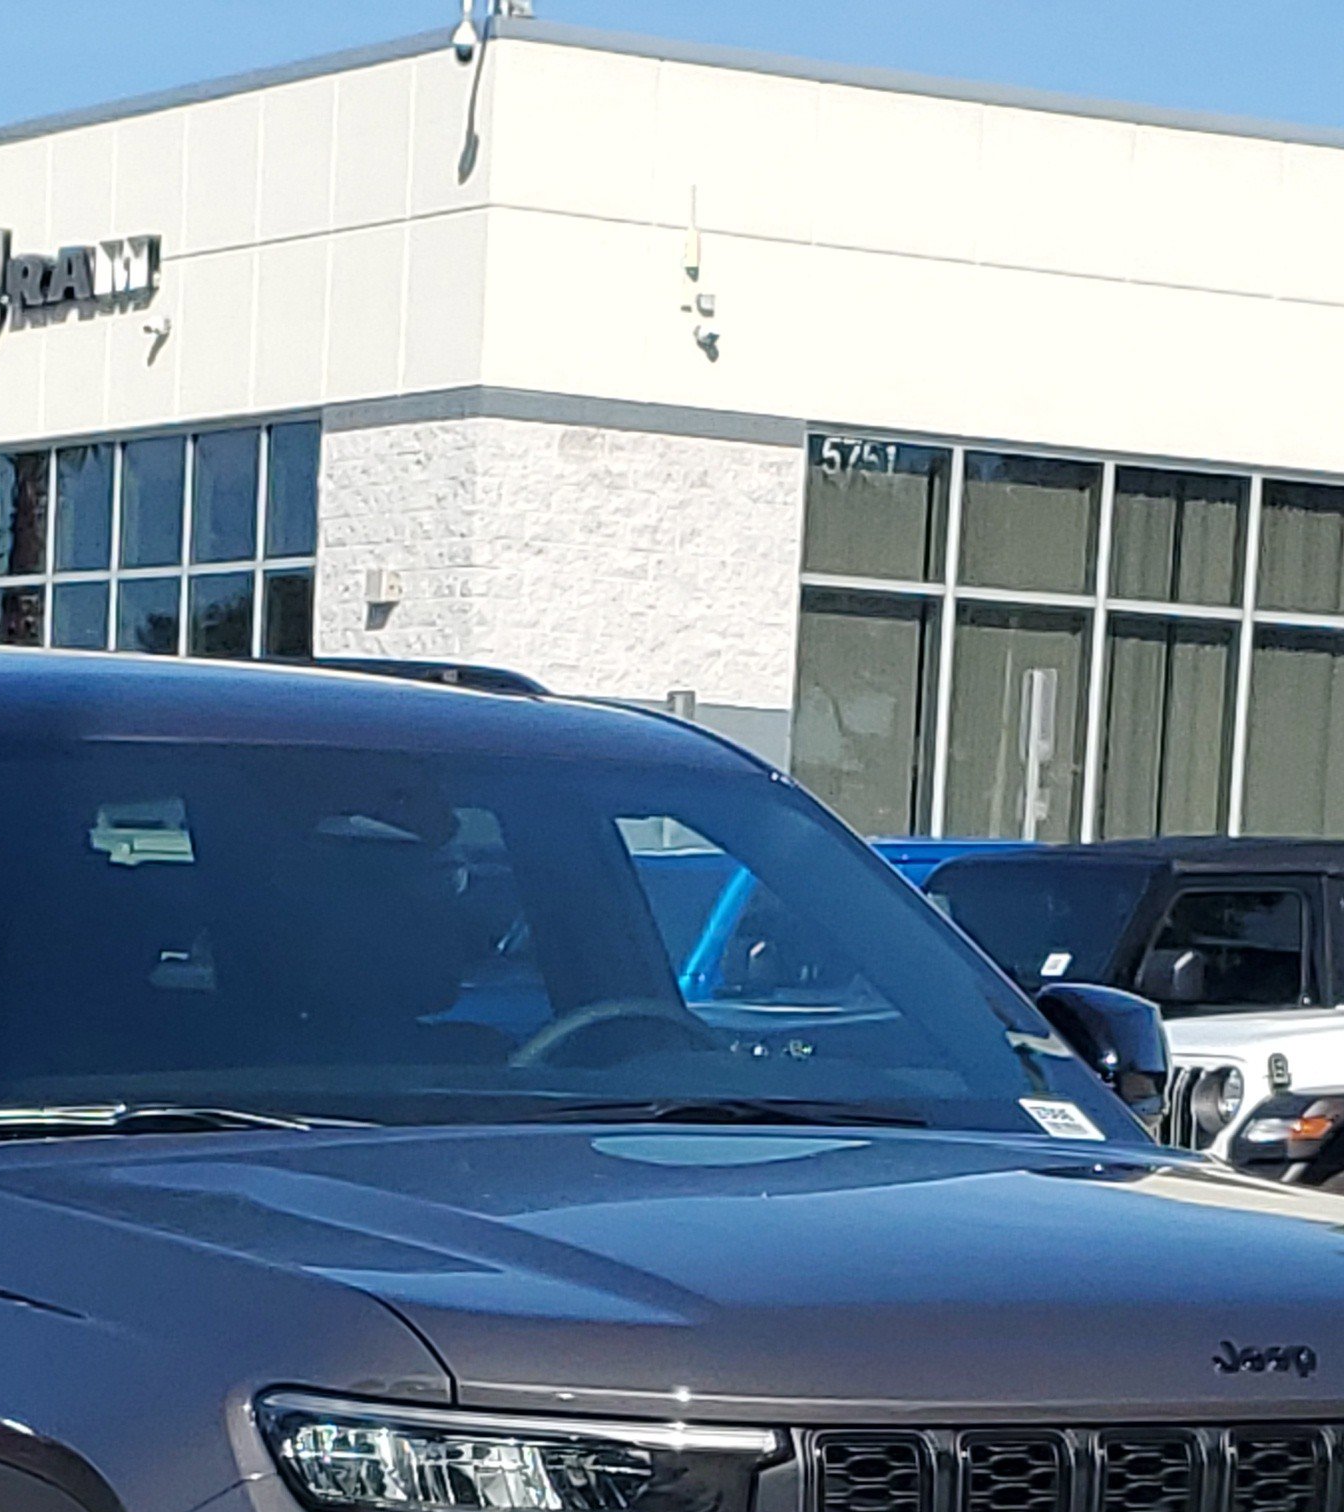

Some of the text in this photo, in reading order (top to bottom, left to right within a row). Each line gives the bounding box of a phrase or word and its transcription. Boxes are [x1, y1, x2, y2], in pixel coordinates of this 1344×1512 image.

[7, 234, 161, 306] RAM
[822, 437, 897, 476] 5751
[1211, 1340, 1317, 1378] Jeep
